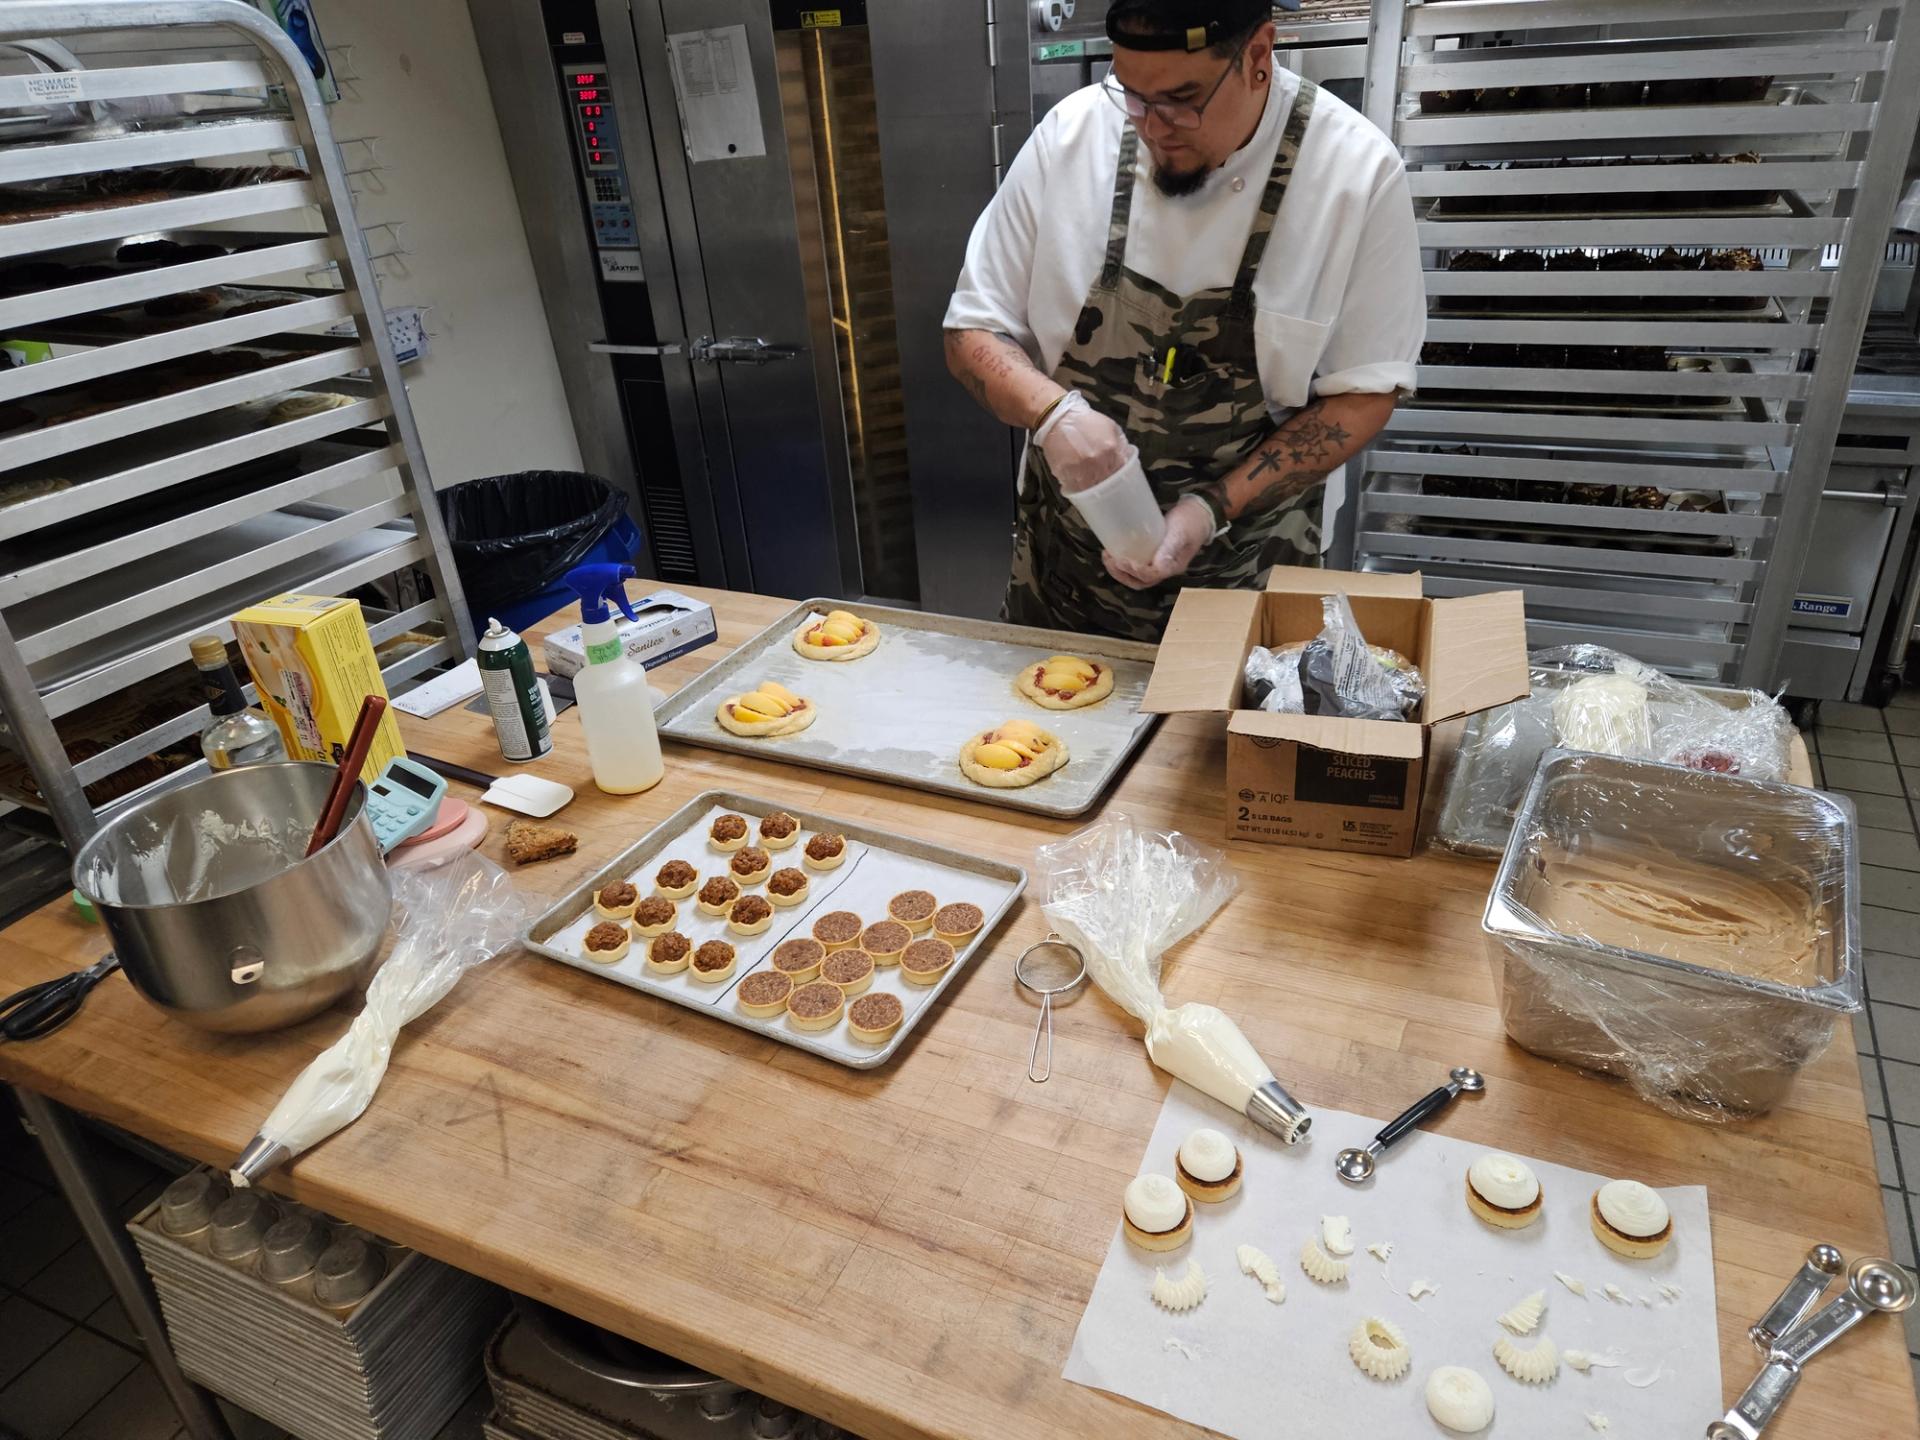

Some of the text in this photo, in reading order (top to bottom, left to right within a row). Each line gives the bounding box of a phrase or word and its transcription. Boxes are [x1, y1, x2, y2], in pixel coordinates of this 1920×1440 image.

[1799, 601, 1838, 613] Range
[626, 636, 665, 657] Sanitex
[1332, 755, 1371, 767] SLICED
[1327, 767, 1376, 780] PEACHES
[1270, 793, 1289, 804] IQF
[1238, 806, 1250, 821] 2
[1270, 815, 1293, 823] BAGS
